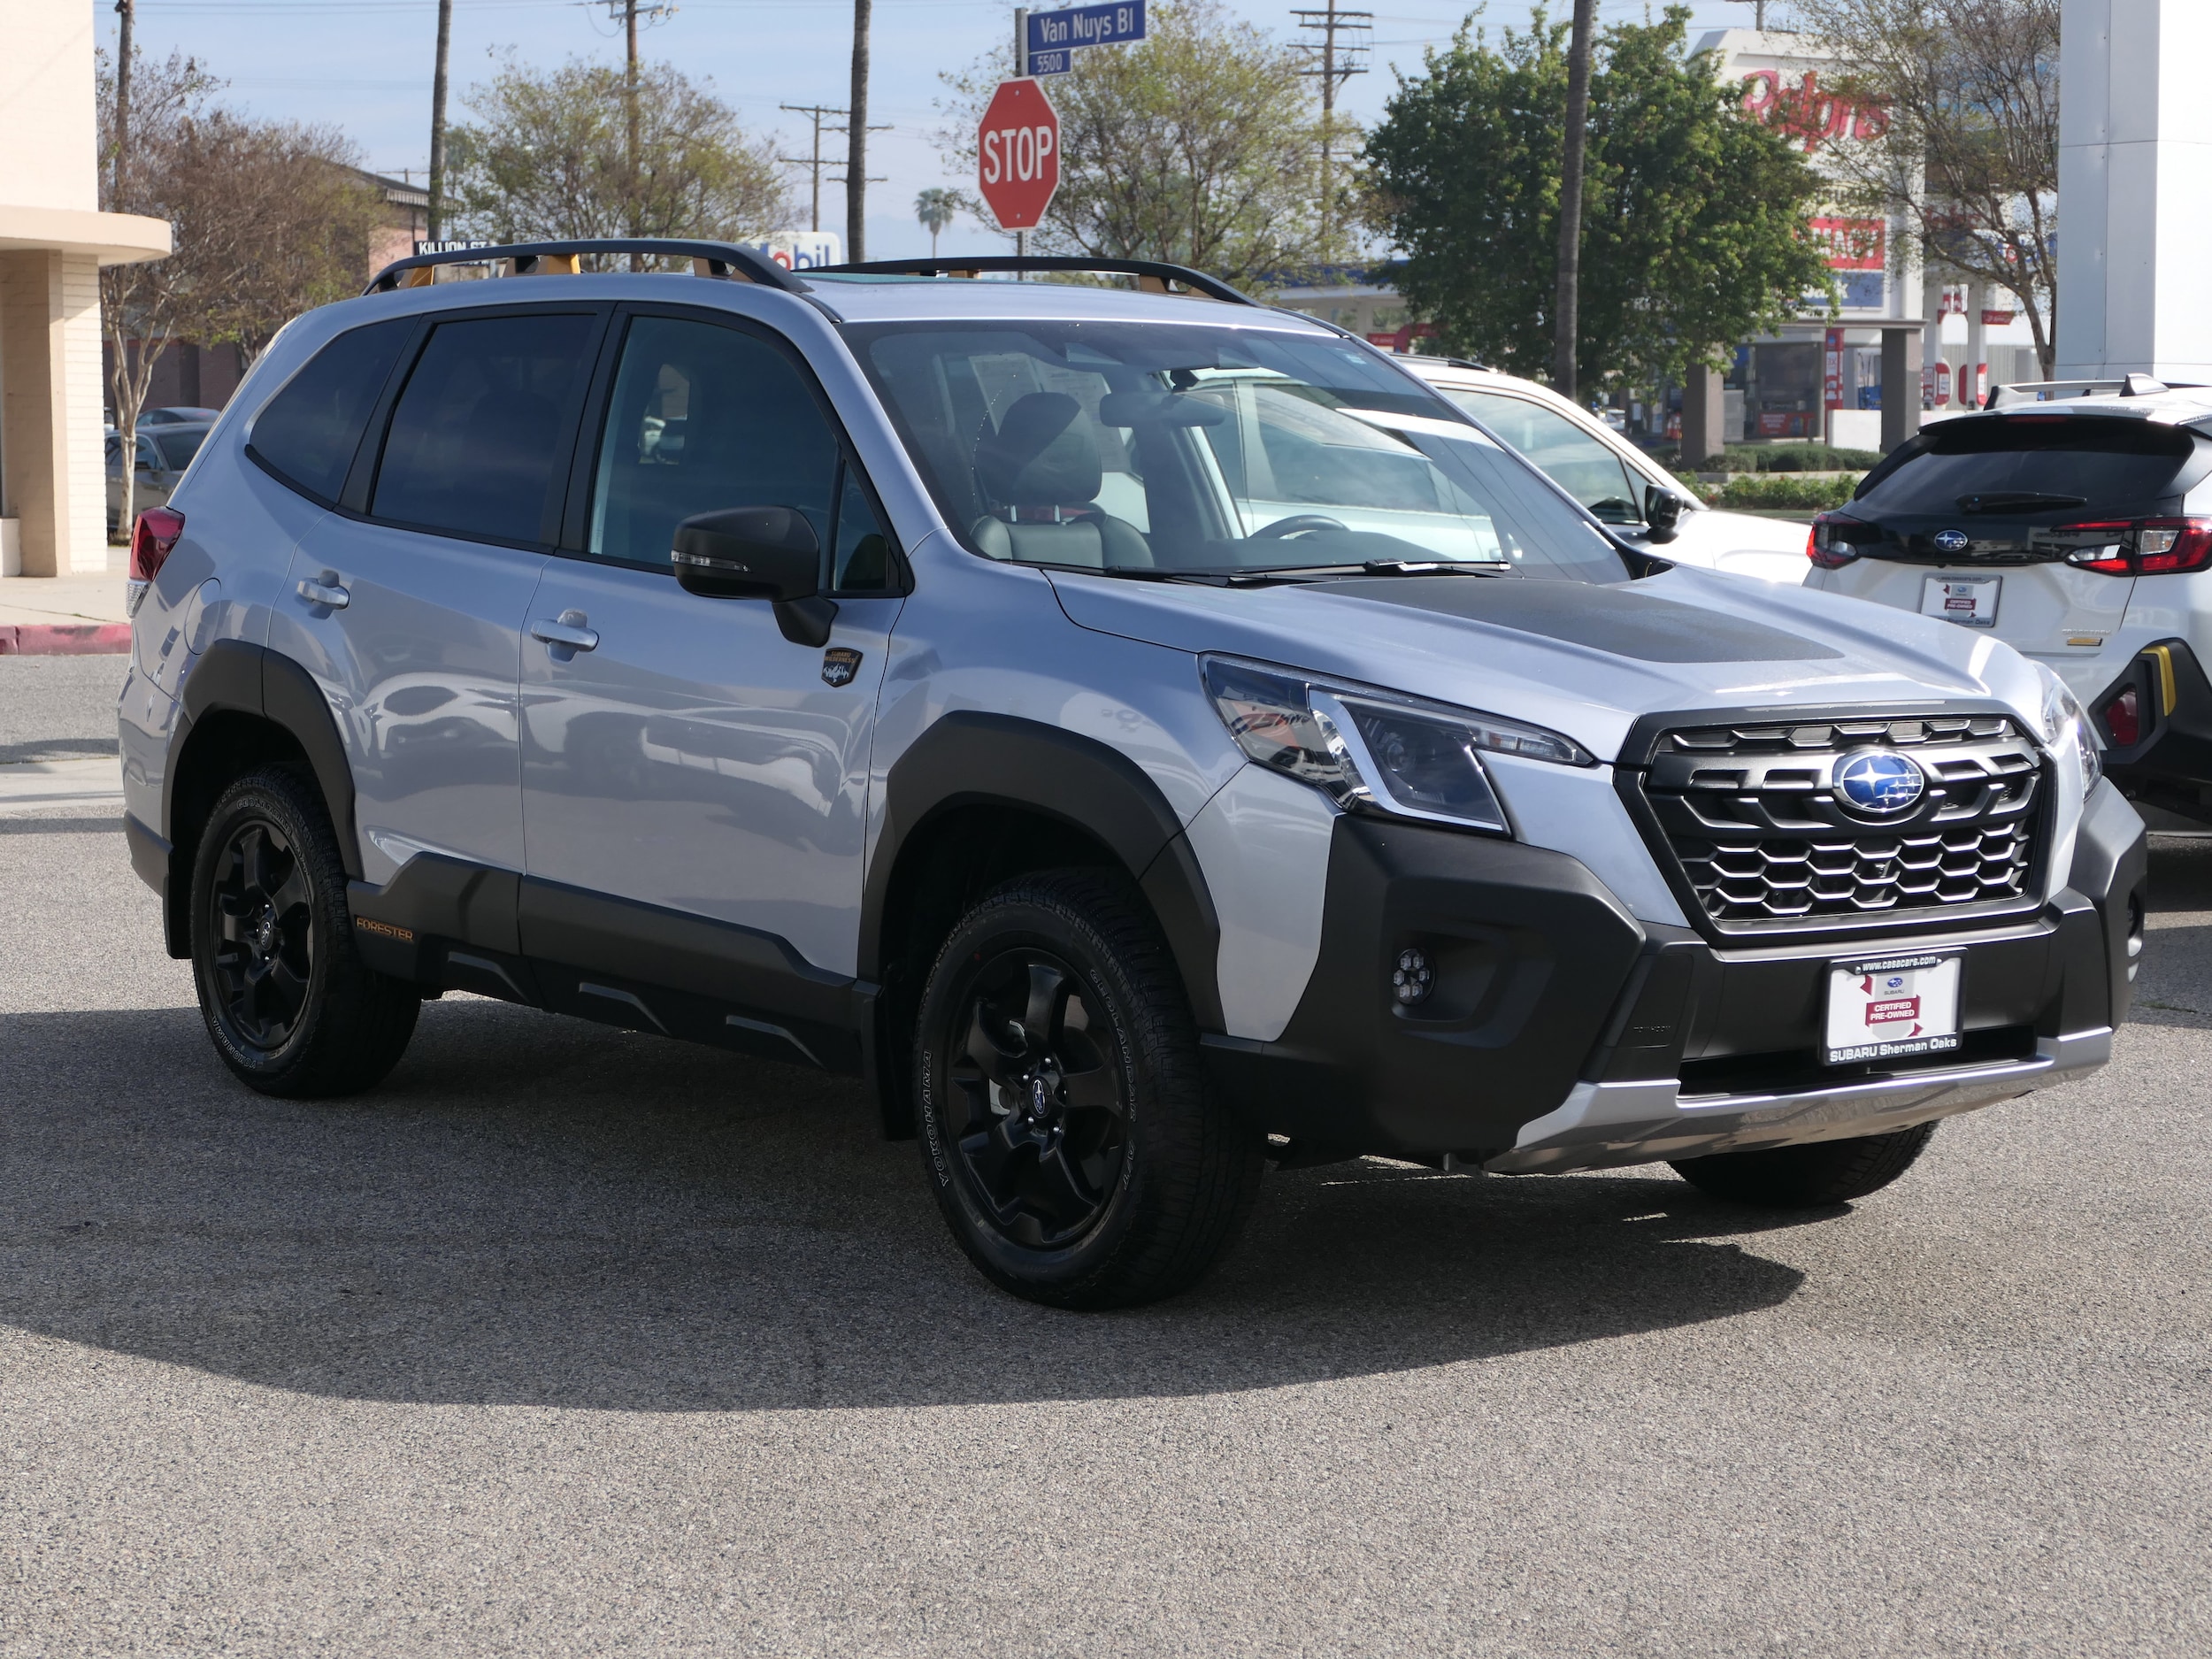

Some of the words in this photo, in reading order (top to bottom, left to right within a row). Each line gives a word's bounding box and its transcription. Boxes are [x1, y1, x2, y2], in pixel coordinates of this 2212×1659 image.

[1041, 18, 1067, 43] Van
[1073, 13, 1111, 42] Nuys
[1118, 8, 1133, 34] Bl
[1037, 53, 1062, 73] 5500
[984, 125, 1053, 184] STOP
[419, 242, 466, 255] KILLION
[741, 242, 830, 270] obil
[356, 917, 414, 943] FORESTER
[1863, 956, 1936, 972] www.casacars.com
[1870, 1010, 1915, 1021] PRE-OWNED
[1874, 1002, 1912, 1012] CERTIFIED
[1089, 968, 1138, 1123] GEOLANDAR
[1830, 1046, 1878, 1063] SUBARU
[1879, 1041, 1927, 1056] Sherman
[1930, 1038, 1957, 1050] Oaks
[922, 1050, 949, 1187] YOKOHAMA
